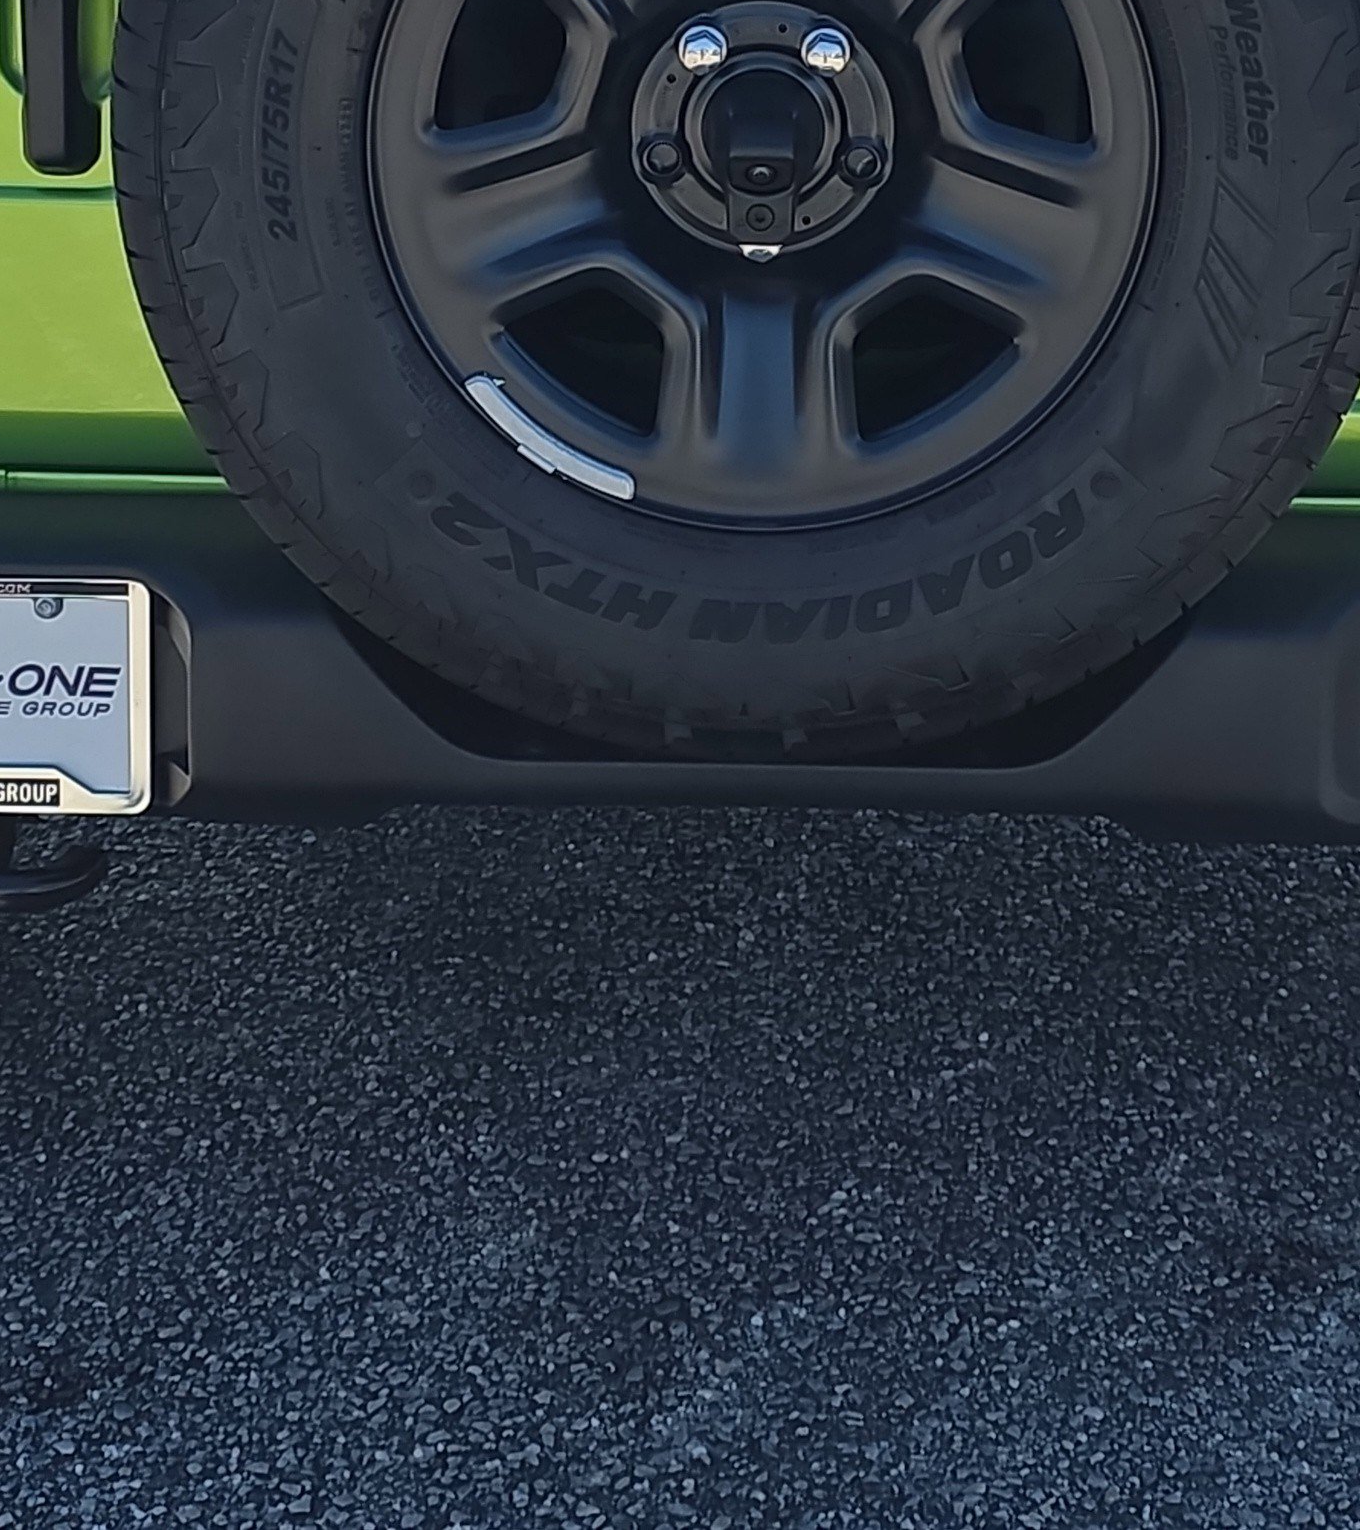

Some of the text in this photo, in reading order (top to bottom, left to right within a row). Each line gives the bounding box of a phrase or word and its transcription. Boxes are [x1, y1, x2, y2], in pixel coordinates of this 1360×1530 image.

[259, 27, 303, 243] 245/75R17
[1208, 24, 1238, 161] Performance
[431, 489, 1083, 643] ROADIAN HTX2
[22, 701, 111, 718] GROUP
